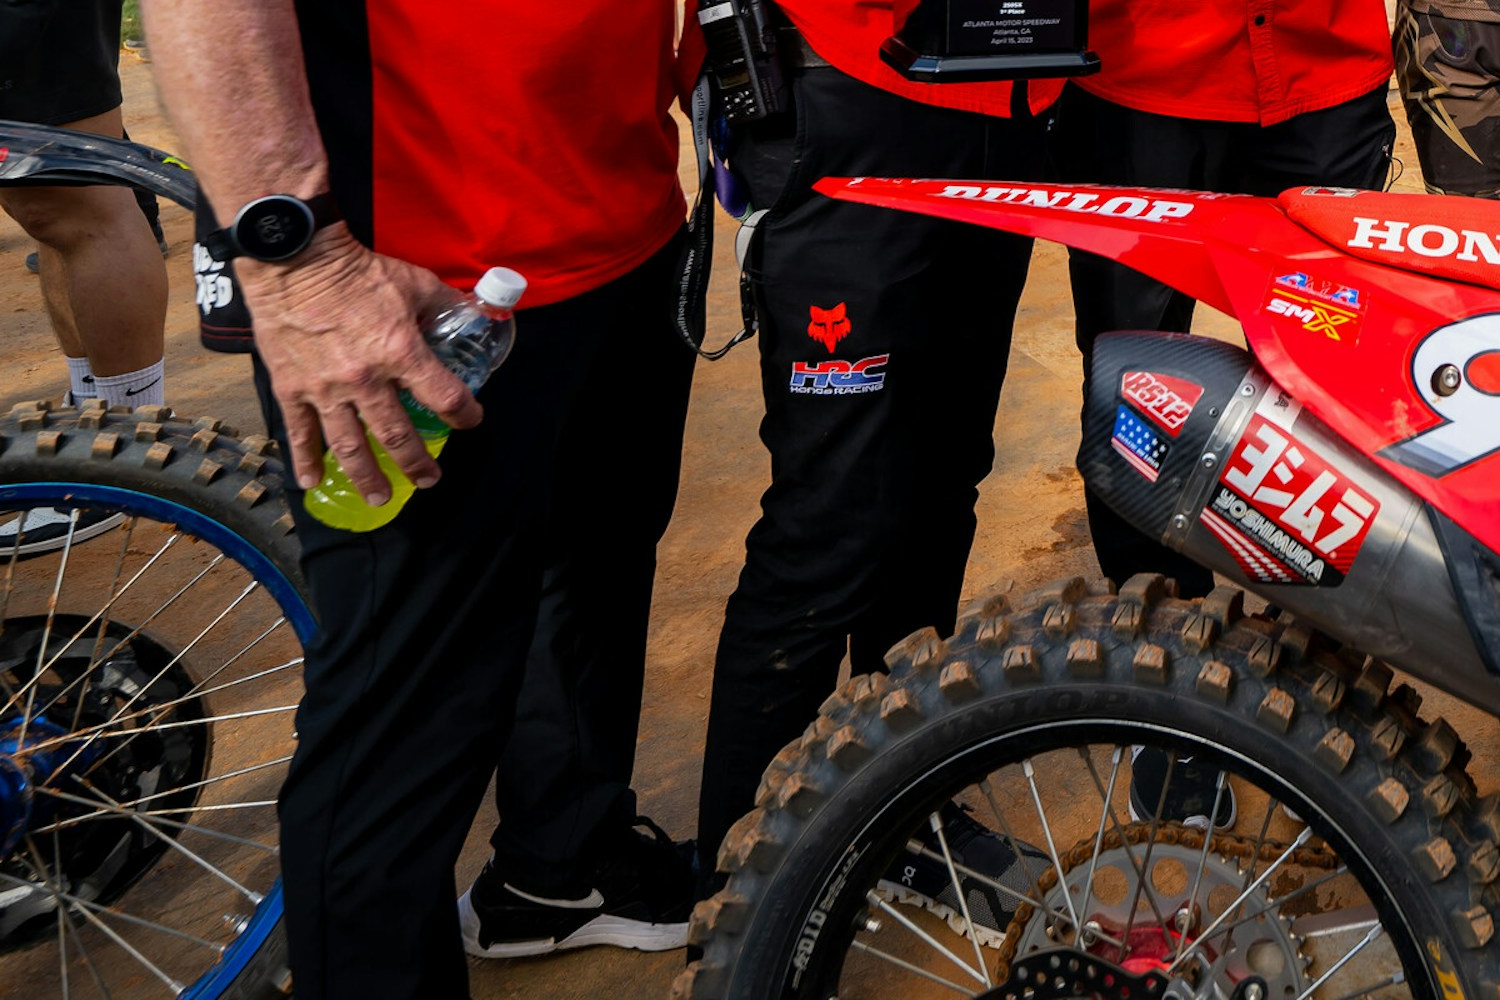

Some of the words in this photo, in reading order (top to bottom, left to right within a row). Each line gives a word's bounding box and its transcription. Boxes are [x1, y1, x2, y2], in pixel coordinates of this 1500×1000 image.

[963, 20, 995, 28] ATLANTA
[1023, 18, 1061, 26] SPEEDWAY
[939, 184, 1196, 224] DUNLOP
[1266, 297, 1350, 341] SMX
[790, 353, 890, 388] HRC
[834, 382, 885, 395] RACING
[1225, 423, 1375, 555] ヨシムラ
[1206, 488, 1325, 579] YOSHIMURA
